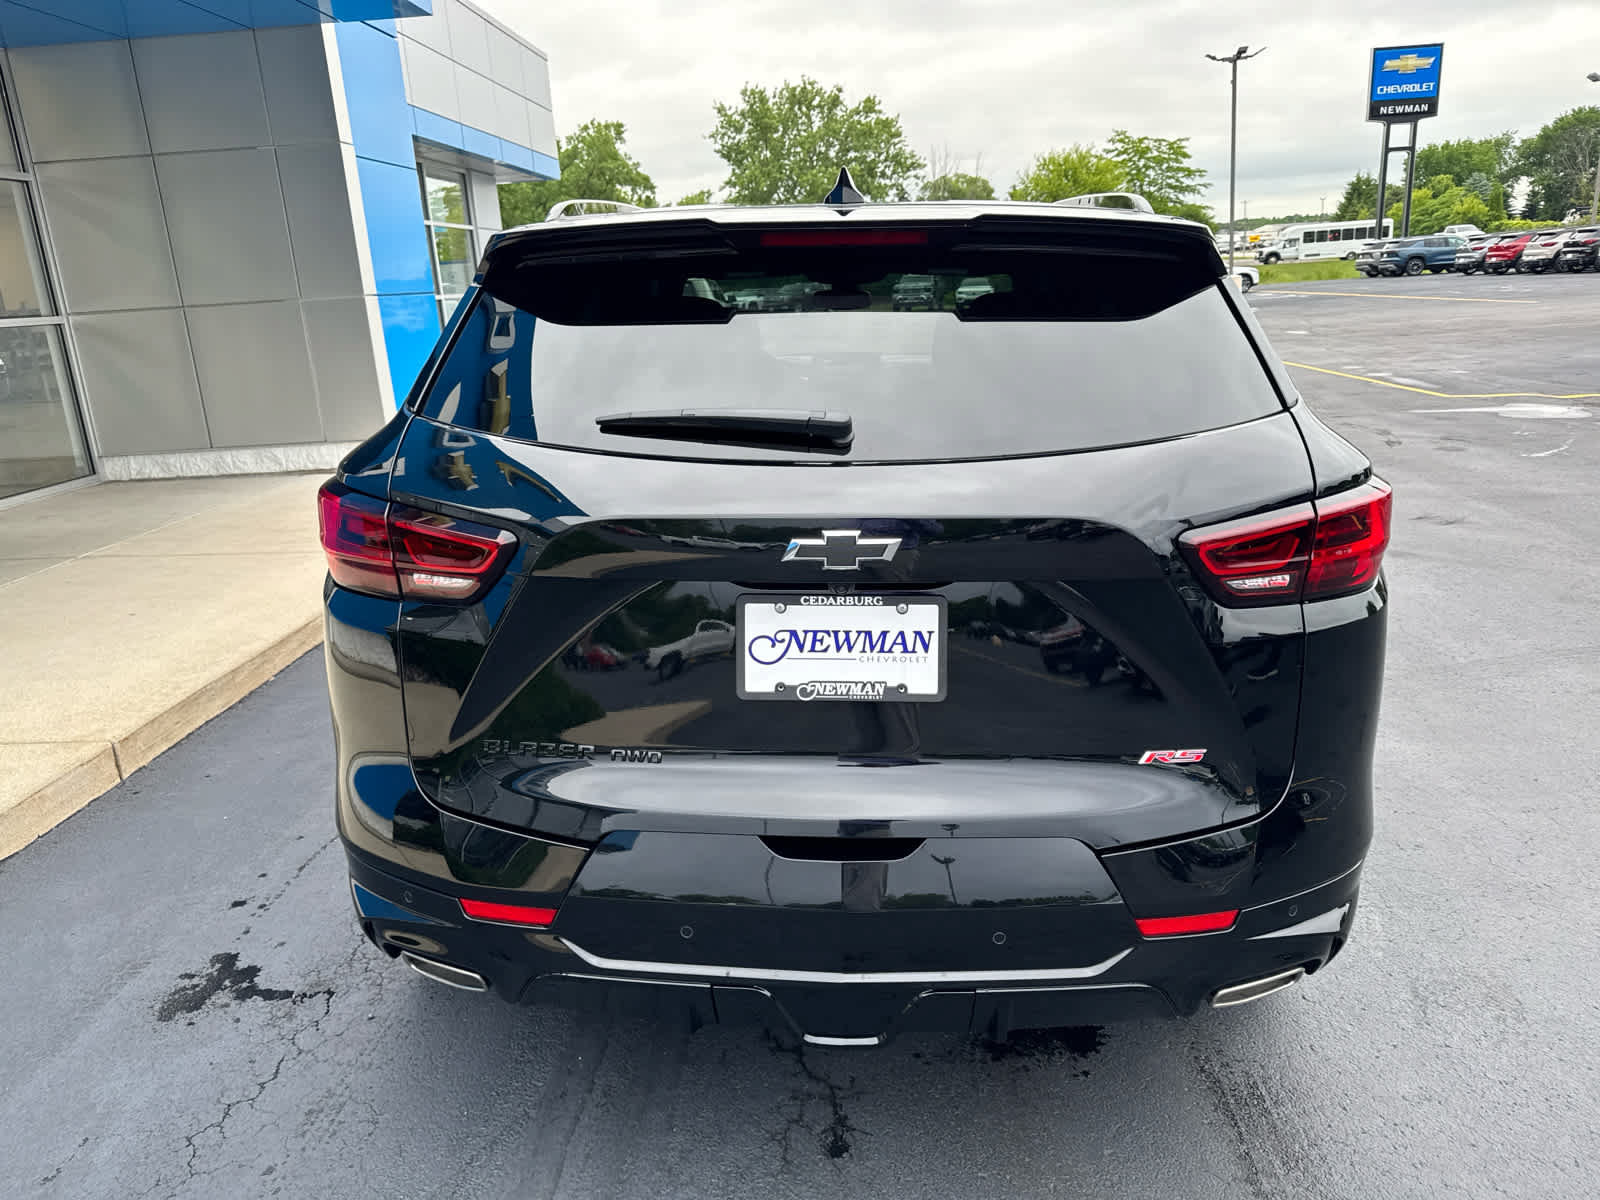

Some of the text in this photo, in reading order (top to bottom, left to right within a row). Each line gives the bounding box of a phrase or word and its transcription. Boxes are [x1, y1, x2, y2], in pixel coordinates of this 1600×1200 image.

[1377, 82, 1435, 95] CHEVROLET
[1380, 103, 1429, 115] NEWMAN
[800, 595, 883, 606] CEDARBURG
[748, 629, 935, 665] NEWMAN
[858, 655, 929, 664] CHEVROLET
[796, 681, 886, 701] NEWMAN
[481, 739, 663, 764] BLAZER AWD
[1138, 748, 1208, 765] RS
